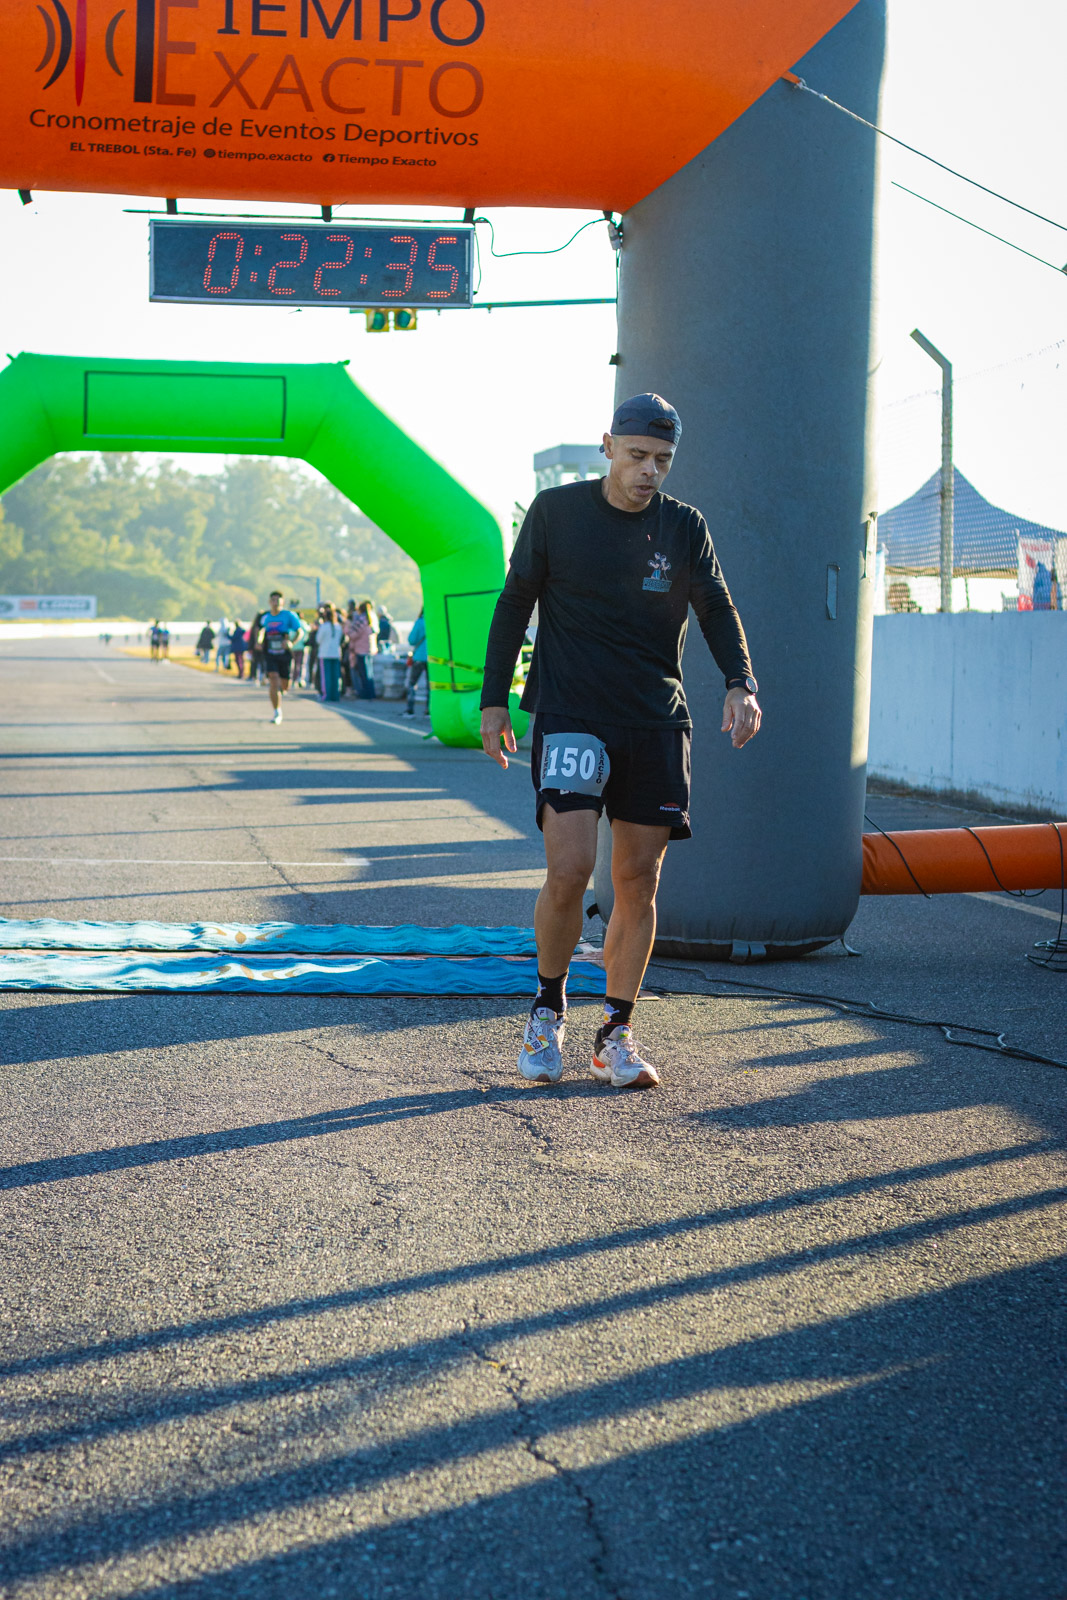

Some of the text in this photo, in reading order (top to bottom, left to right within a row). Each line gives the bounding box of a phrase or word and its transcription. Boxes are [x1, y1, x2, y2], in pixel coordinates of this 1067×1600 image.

[29, 108, 480, 147] Cronometraje de Eventos Deportivos
[69, 142, 86, 152] EL
[88, 142, 141, 155] TREBOL
[143, 145, 174, 156] (Sta.
[176, 147, 197, 159] Fe)
[337, 153, 389, 167] Tiempo
[392, 156, 437, 167] Exacto
[203, 232, 459, 298] 0:22:35
[547, 746, 596, 781] 150
